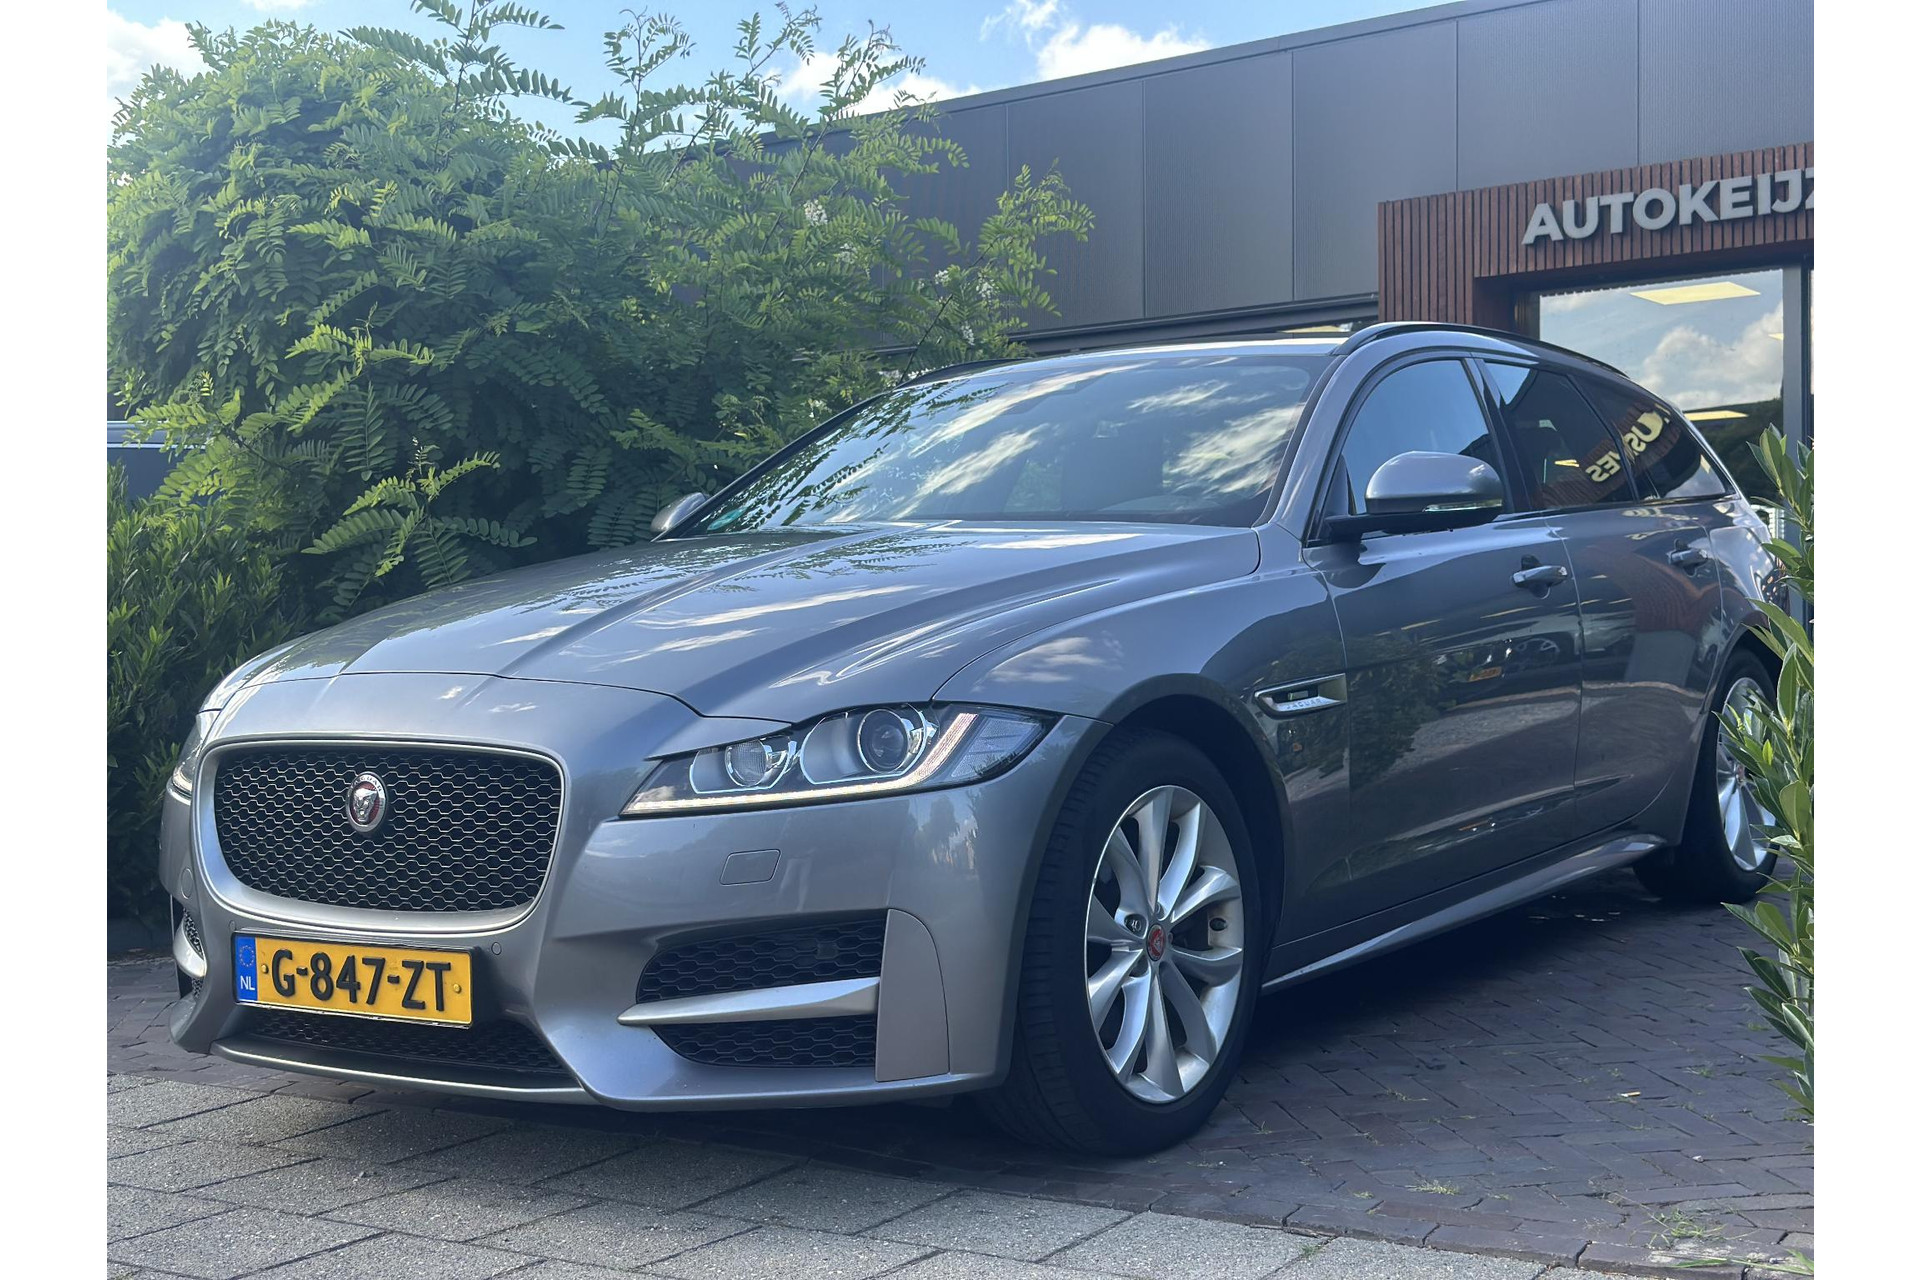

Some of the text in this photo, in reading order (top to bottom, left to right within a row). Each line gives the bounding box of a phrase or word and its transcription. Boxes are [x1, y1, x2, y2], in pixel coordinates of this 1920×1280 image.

[1521, 167, 1814, 245] AUTOKEIJ
[240, 975, 256, 991] NL
[271, 948, 452, 1012] G-847-ZT
